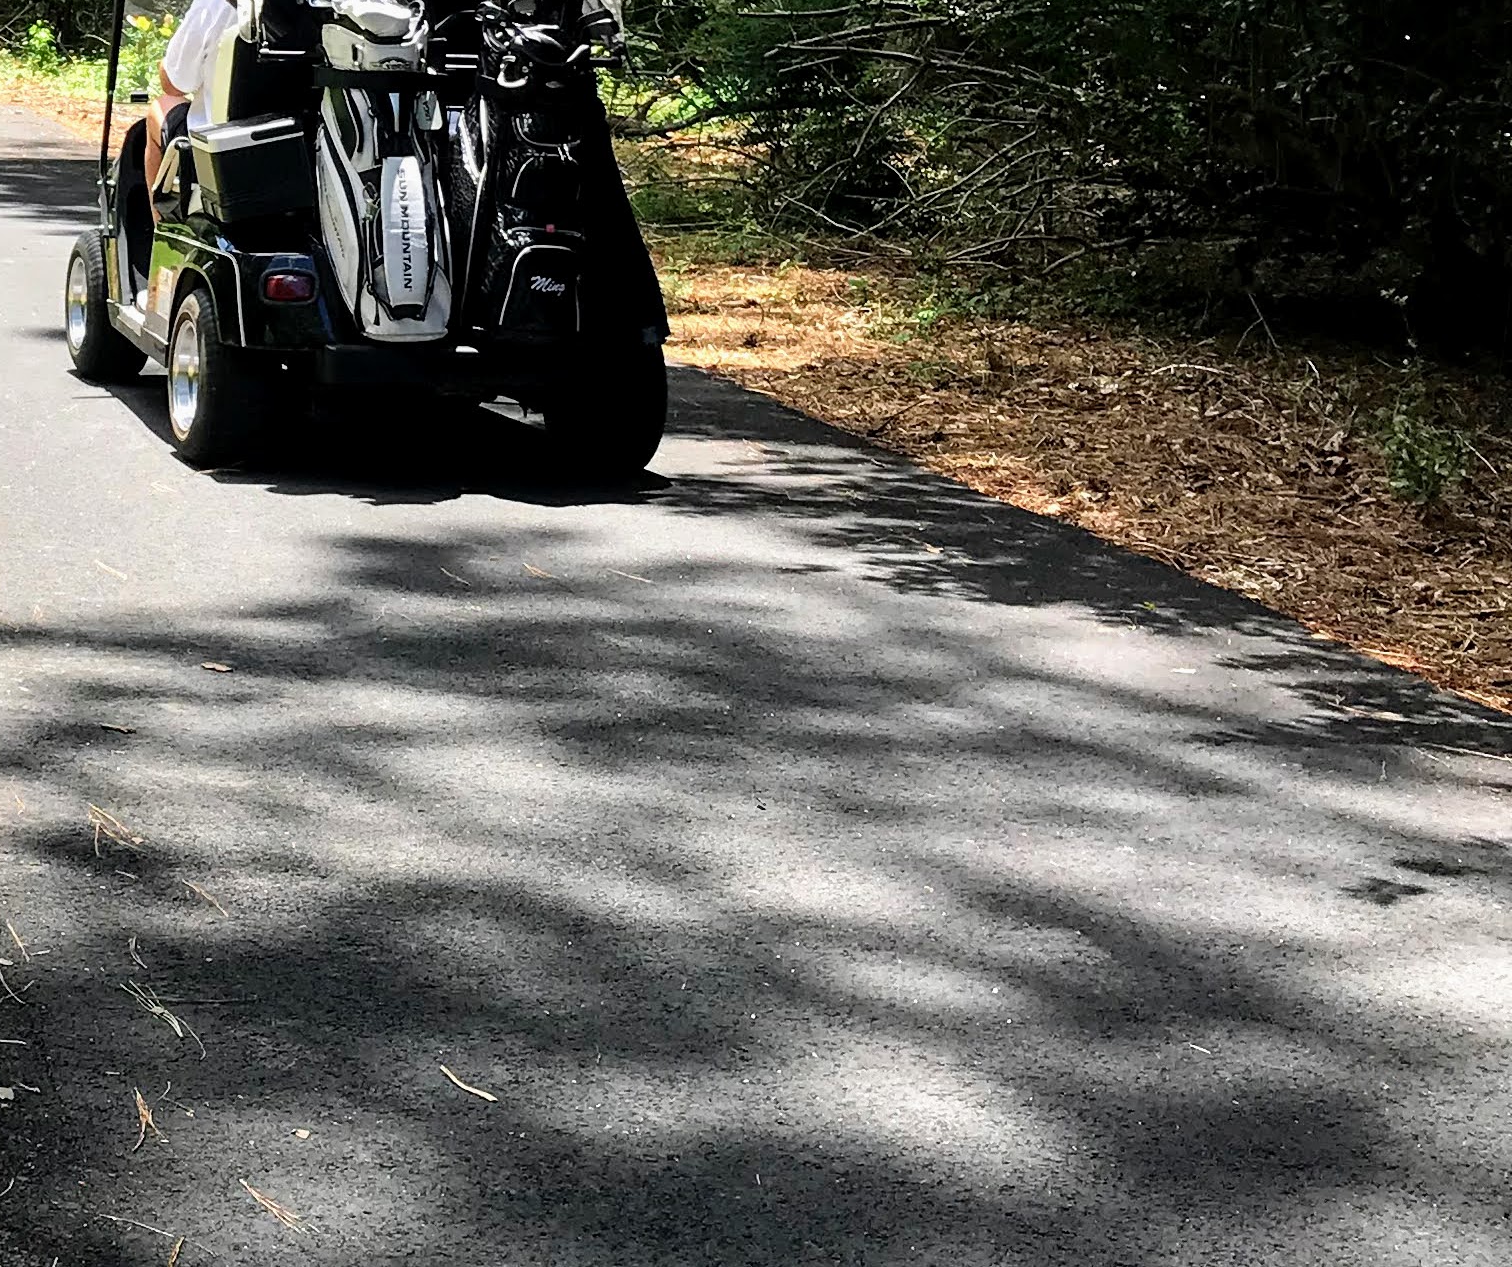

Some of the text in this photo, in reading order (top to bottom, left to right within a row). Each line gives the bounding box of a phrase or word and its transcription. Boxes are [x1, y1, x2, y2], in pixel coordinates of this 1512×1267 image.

[397, 168, 412, 289] SUN MOUNTAIN
[531, 276, 565, 296] Ming
